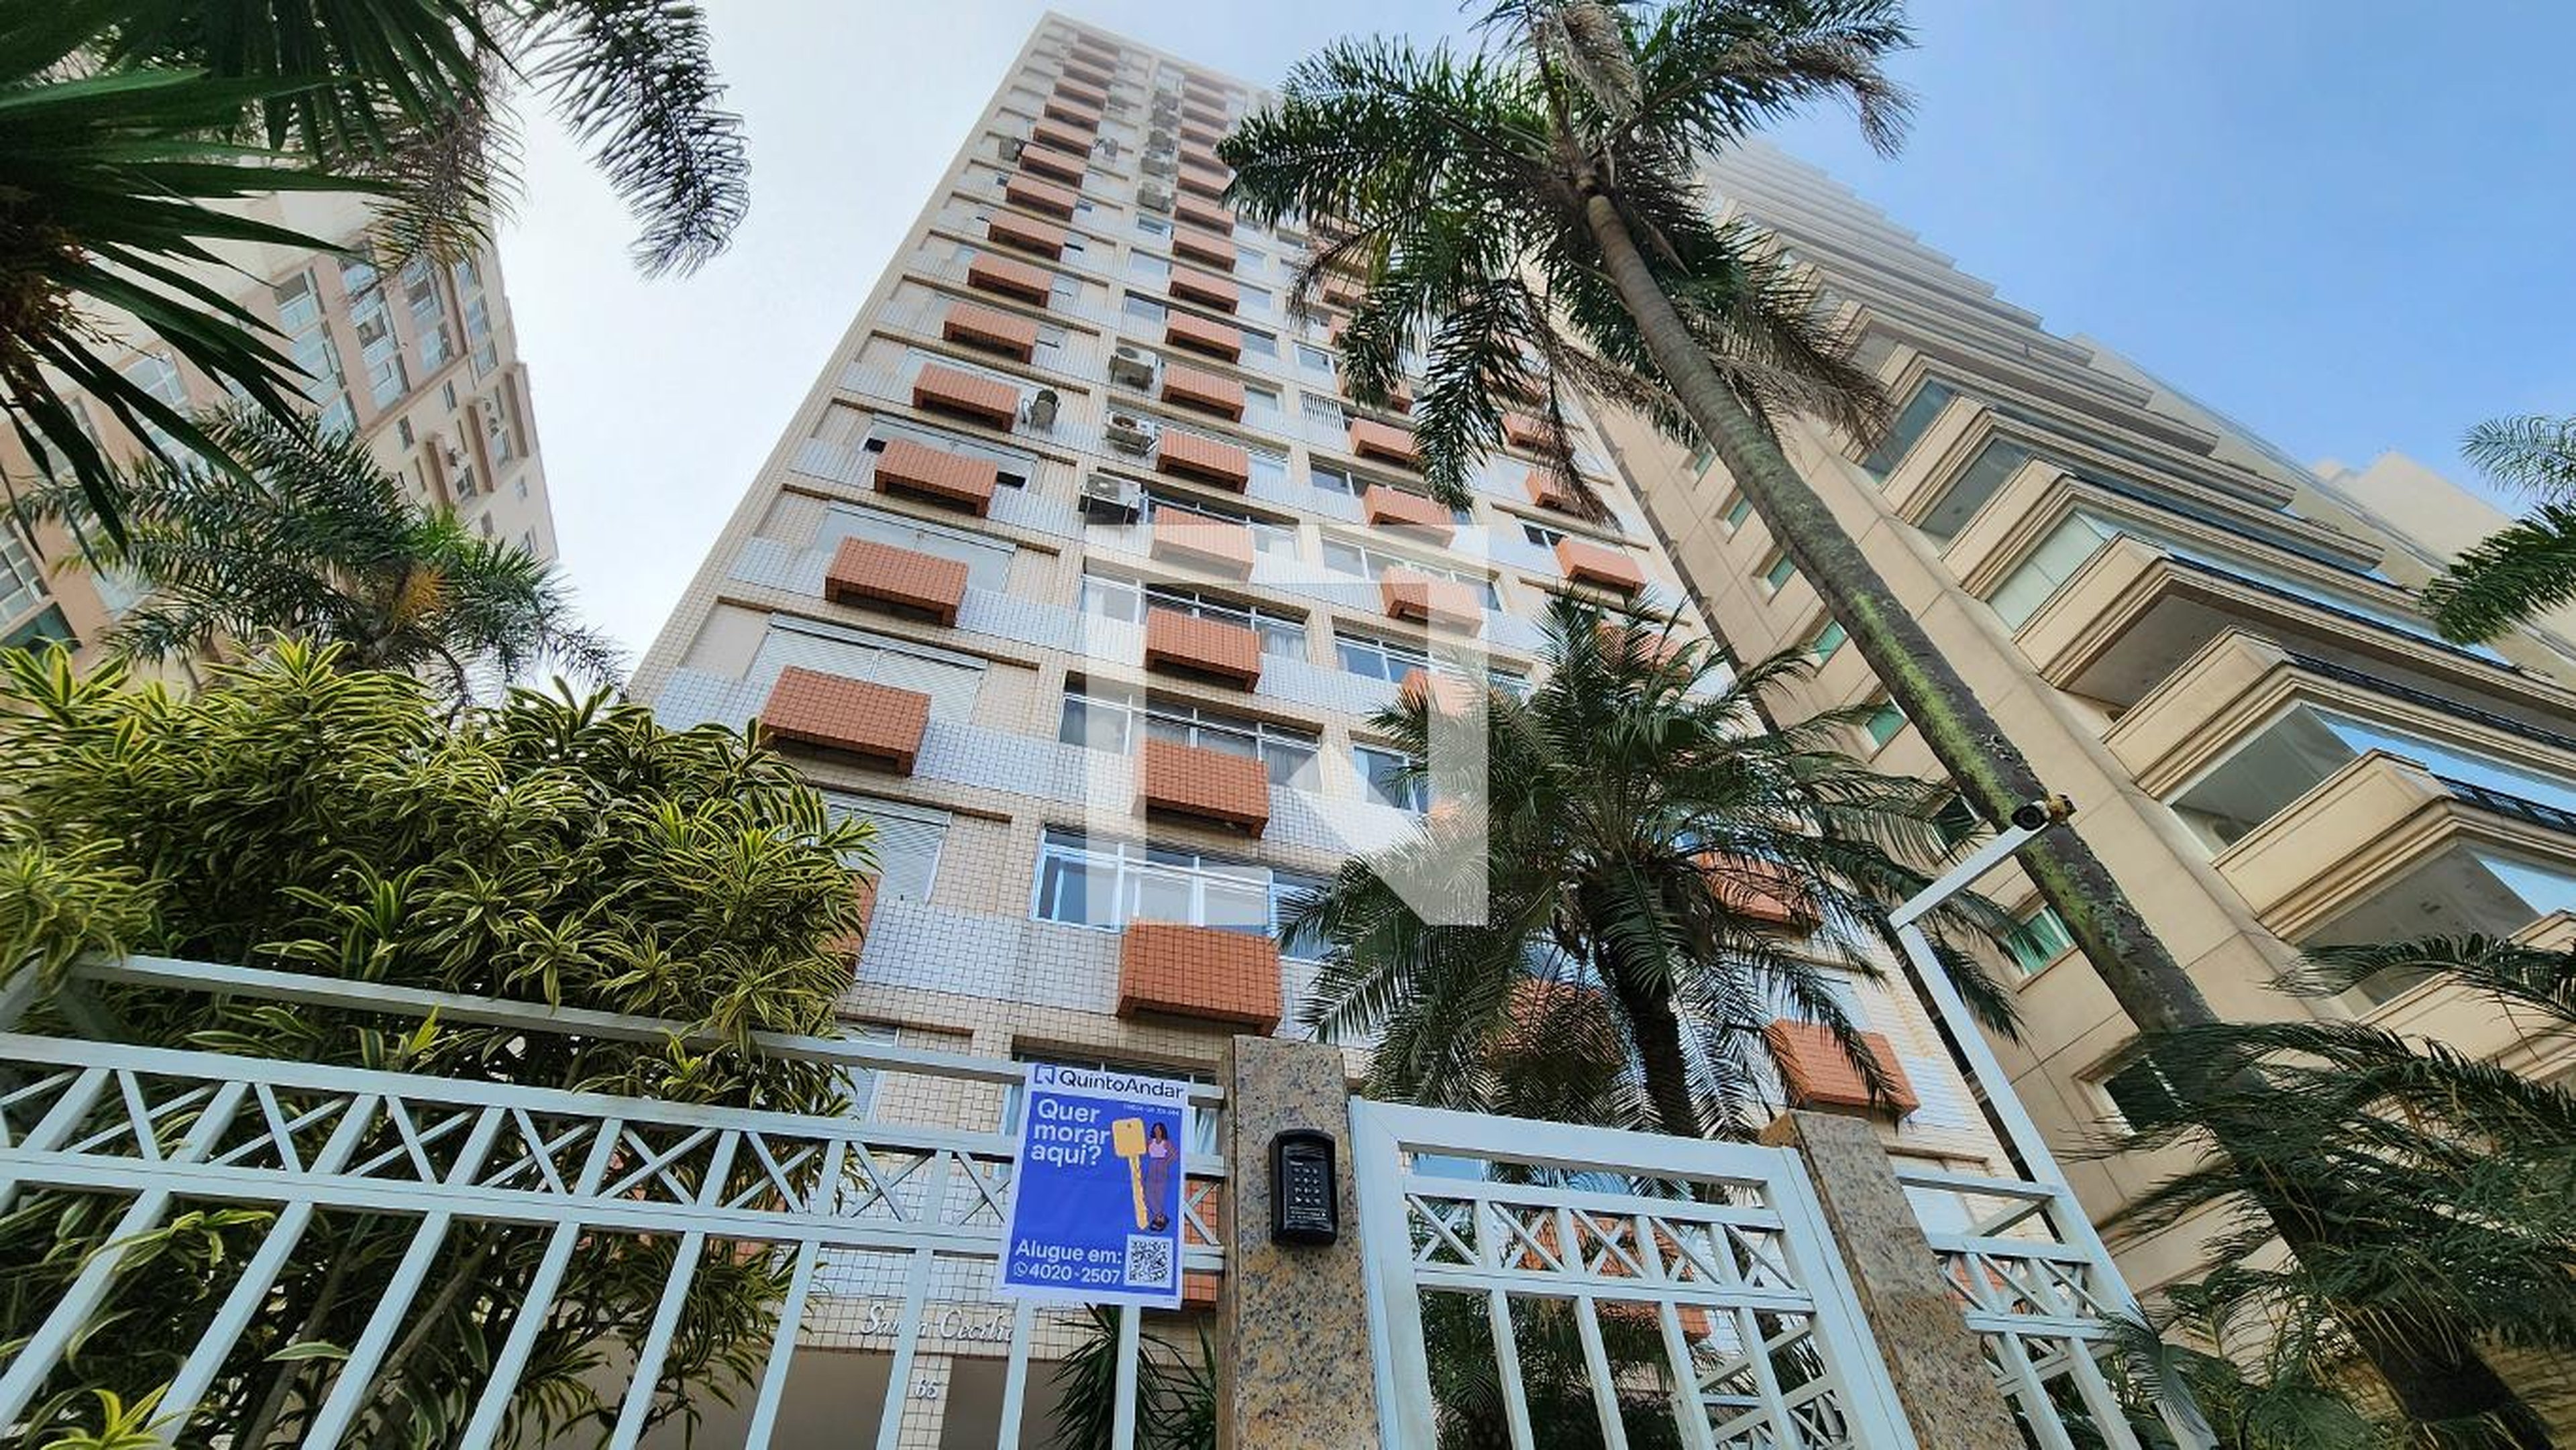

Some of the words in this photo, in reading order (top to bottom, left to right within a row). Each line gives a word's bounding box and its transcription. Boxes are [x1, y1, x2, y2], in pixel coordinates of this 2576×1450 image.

[1059, 1070, 1183, 1099] QuintoAndar
[1036, 1098, 1100, 1124] Quer
[1034, 1124, 1110, 1145] morar
[1030, 1144, 1102, 1167] aqui?
[1015, 1239, 1083, 1263] Alugue
[1087, 1249, 1124, 1265] em:
[1029, 1264, 1120, 1284] 4020-2507
